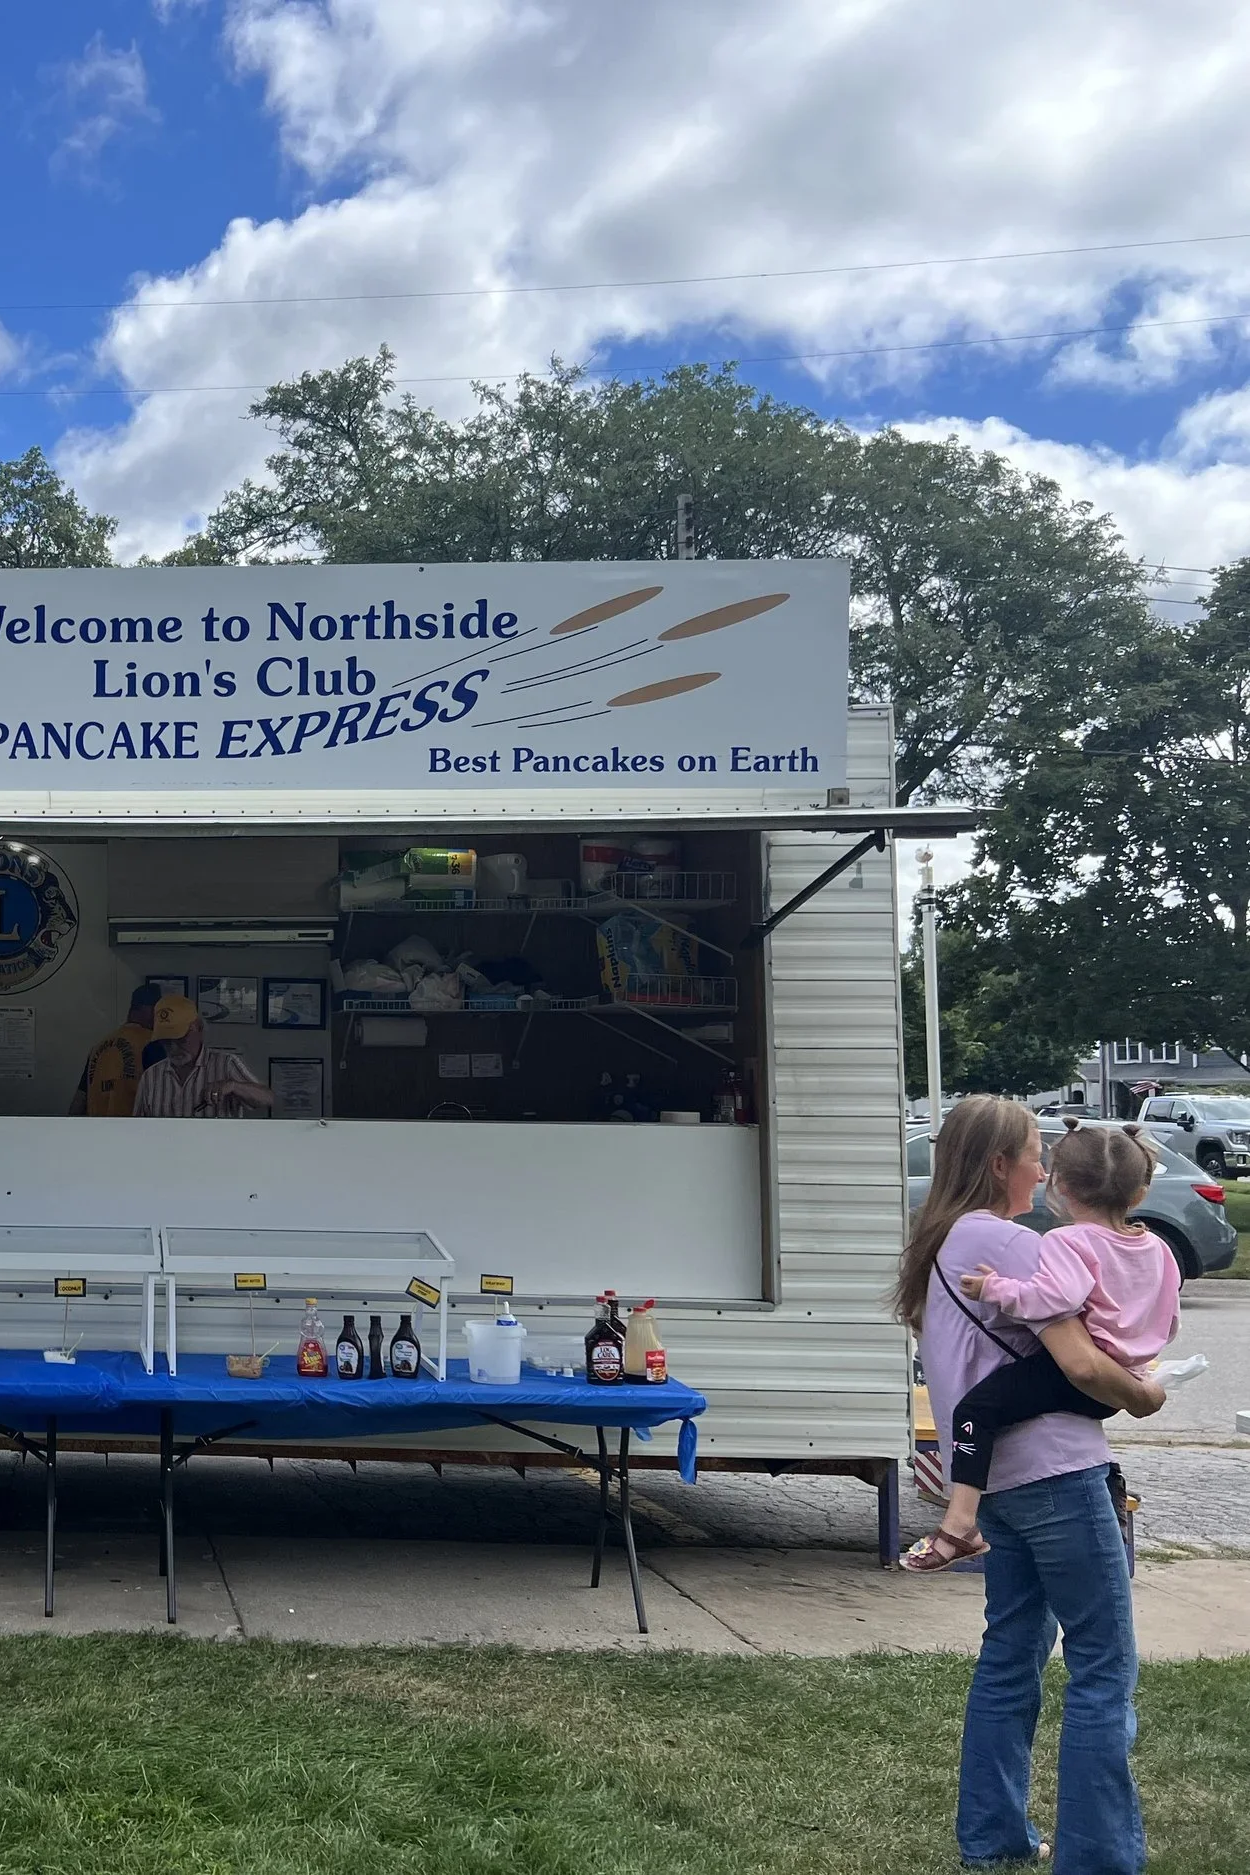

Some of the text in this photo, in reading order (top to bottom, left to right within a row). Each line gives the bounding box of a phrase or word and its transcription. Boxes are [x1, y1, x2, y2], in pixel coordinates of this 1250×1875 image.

[200, 606, 251, 643] to
[265, 598, 519, 642] Northside
[92, 655, 376, 698] Lion's Club
[215, 668, 491, 759] EXPRESS
[428, 746, 819, 773] Best Pancakes on Earth
[606, 927, 621, 990] Napkins
